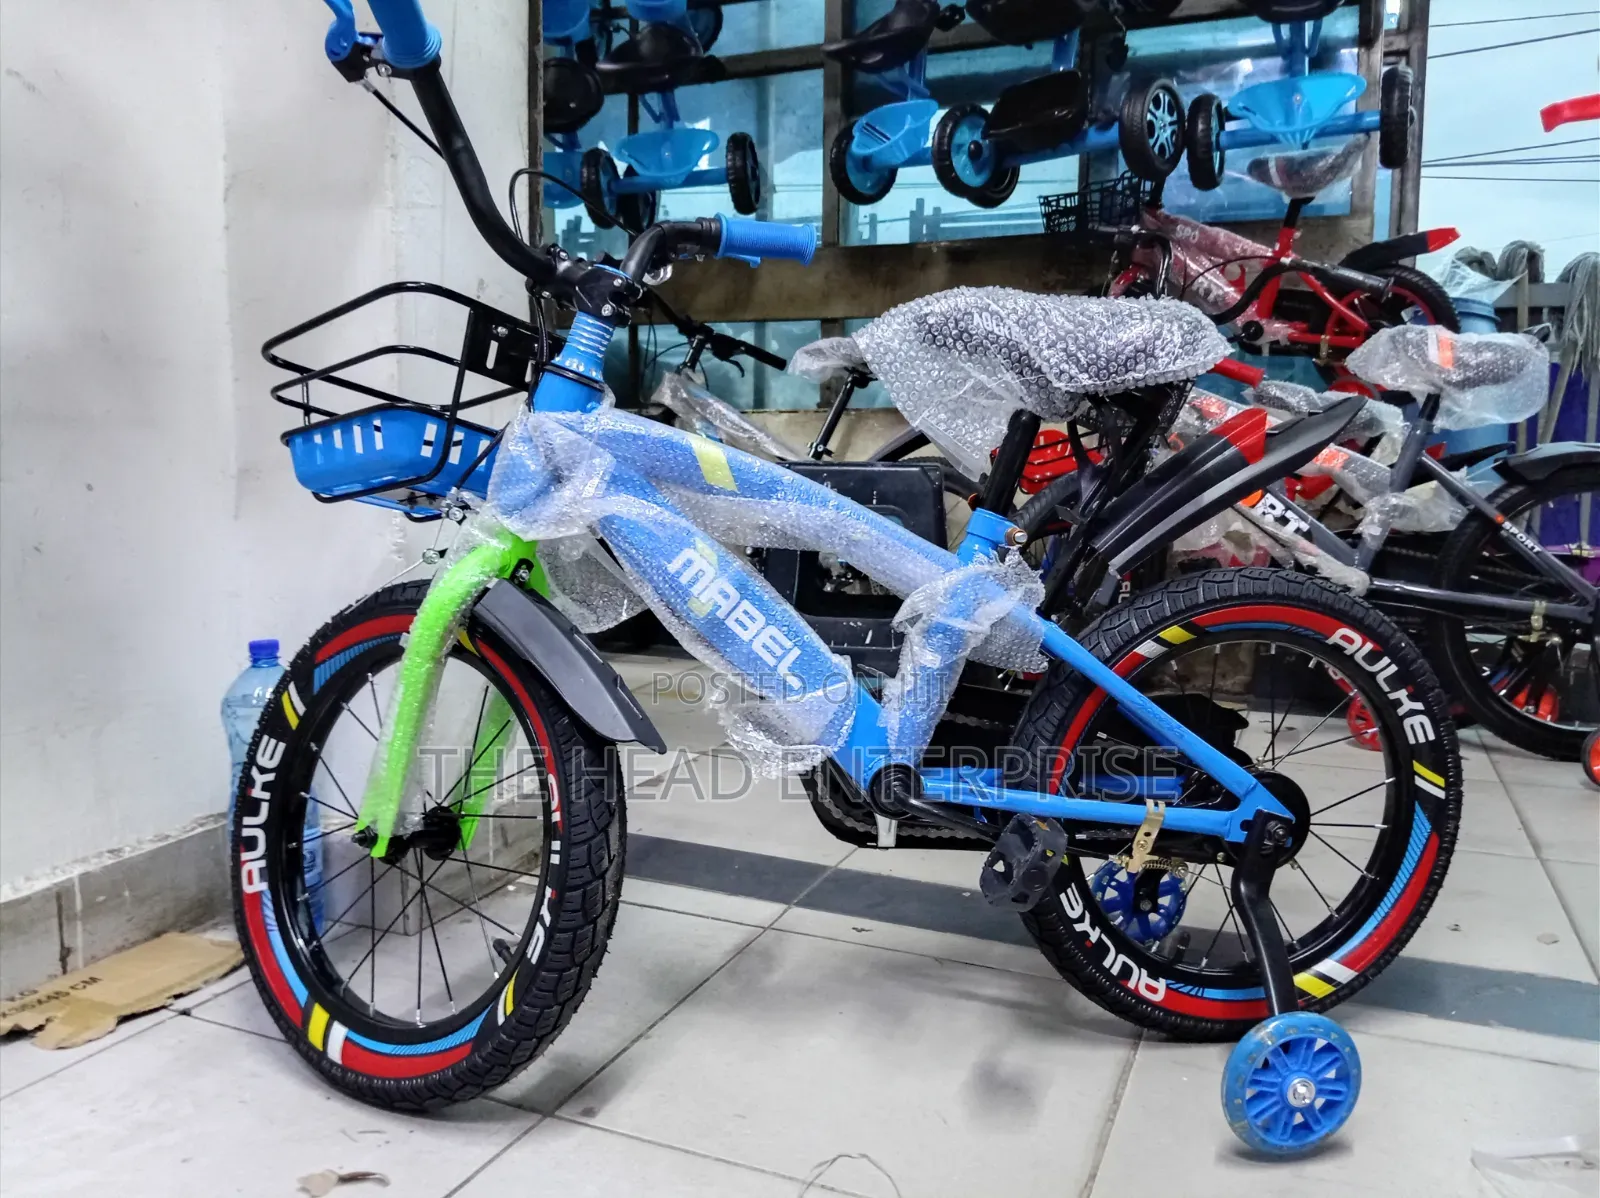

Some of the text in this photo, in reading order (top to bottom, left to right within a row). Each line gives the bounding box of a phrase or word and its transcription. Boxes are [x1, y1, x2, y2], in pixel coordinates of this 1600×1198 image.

[1502, 521, 1542, 552] SPORT
[667, 548, 802, 691] MABEL
[1326, 627, 1436, 745] AULKE
[241, 734, 287, 894] AULKE
[1059, 882, 1167, 1003] AULKE
